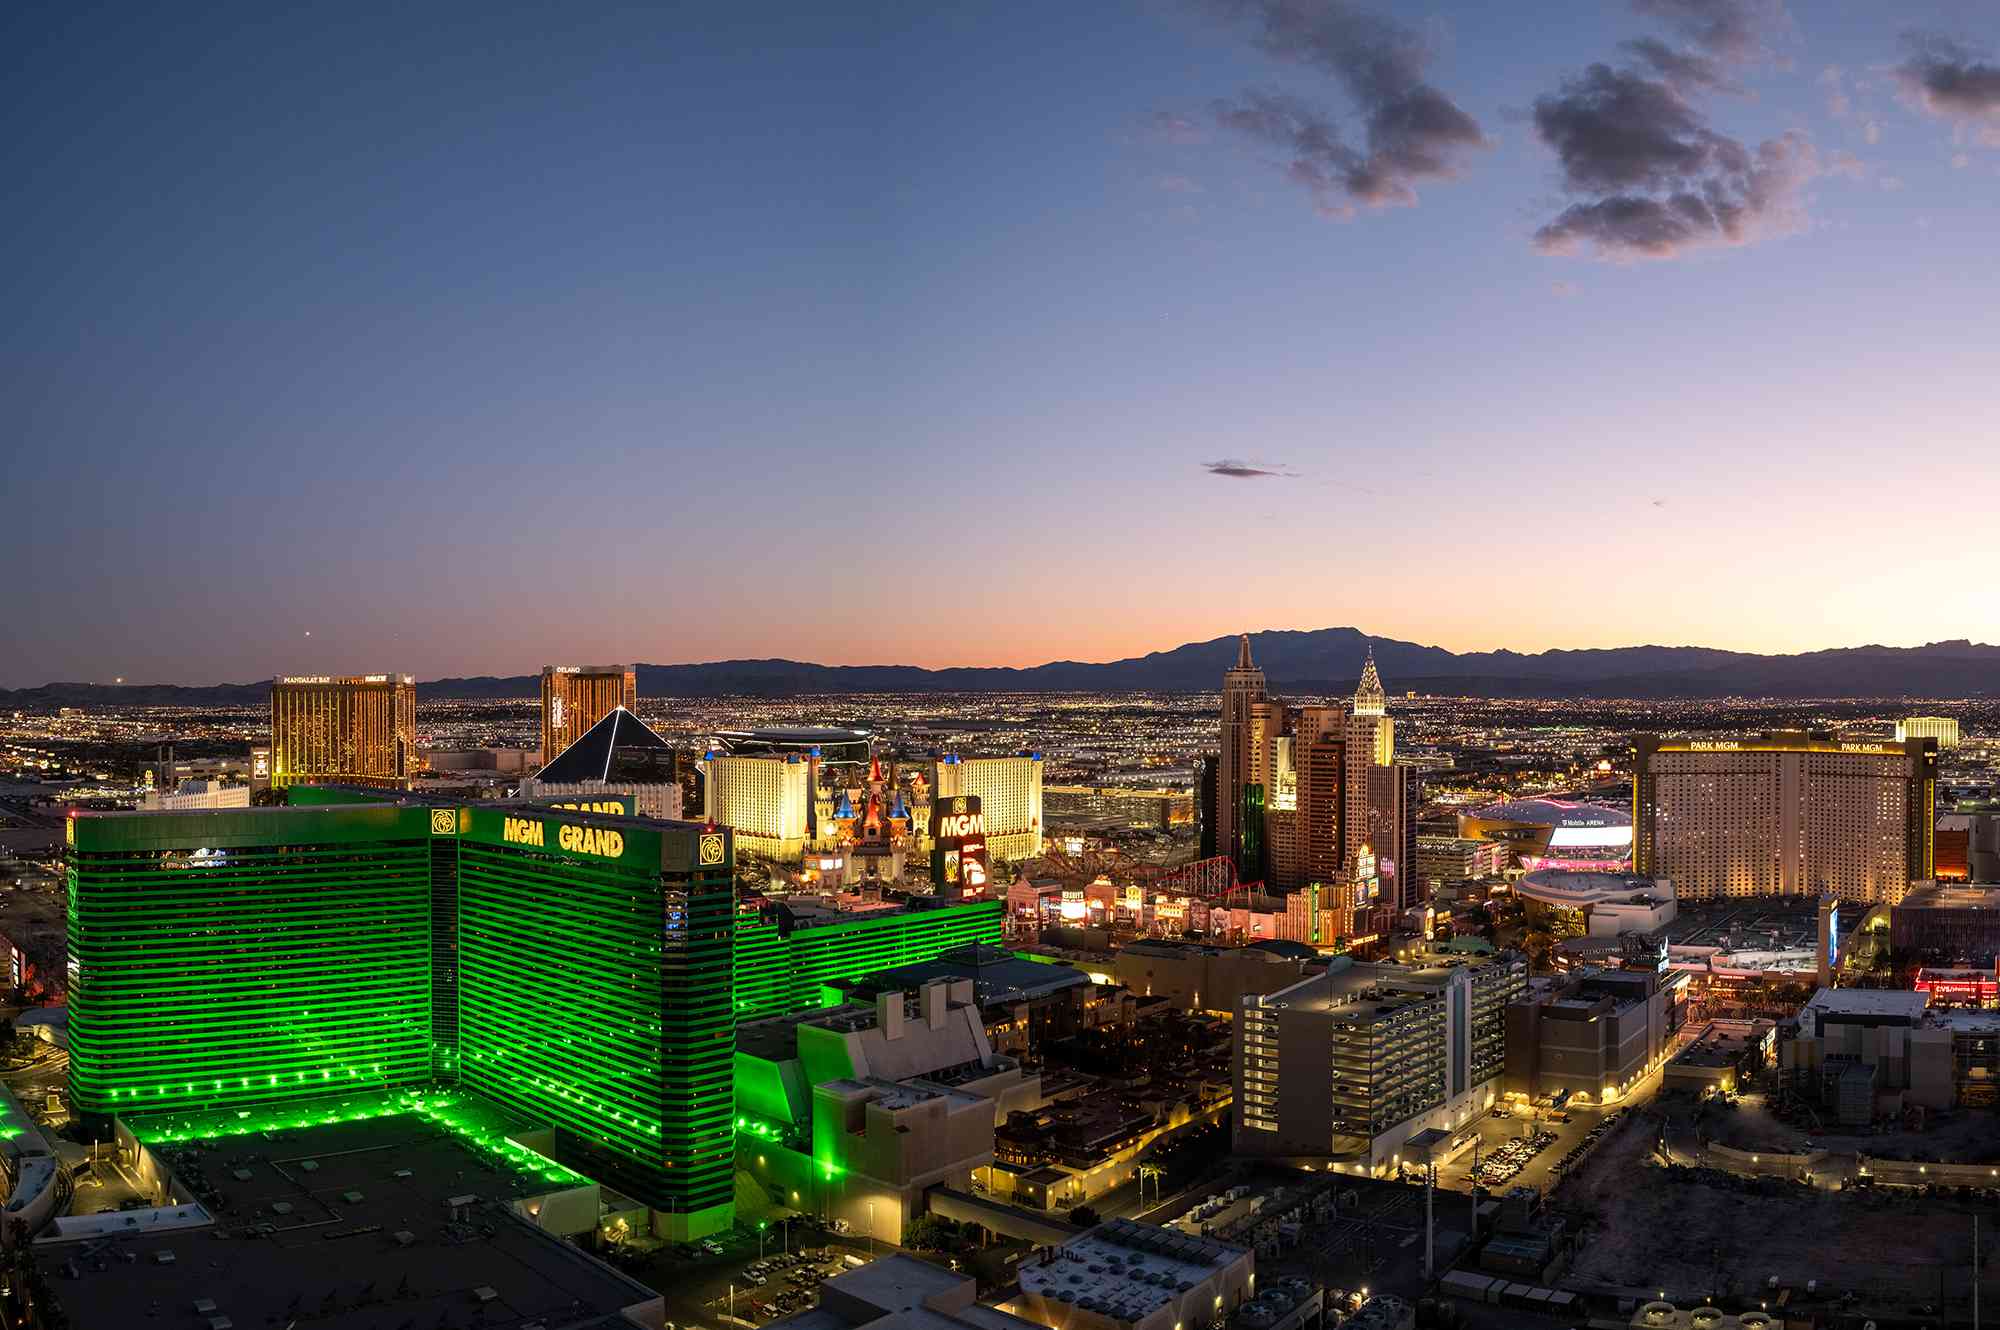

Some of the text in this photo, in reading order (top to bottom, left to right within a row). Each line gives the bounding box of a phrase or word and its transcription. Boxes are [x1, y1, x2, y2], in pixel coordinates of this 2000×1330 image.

[1690, 742, 1738, 751] PARK MGM
[1841, 743, 1883, 753] PARK MGM
[940, 814, 985, 838] MGM
[504, 817, 624, 858] MGM GRAND
